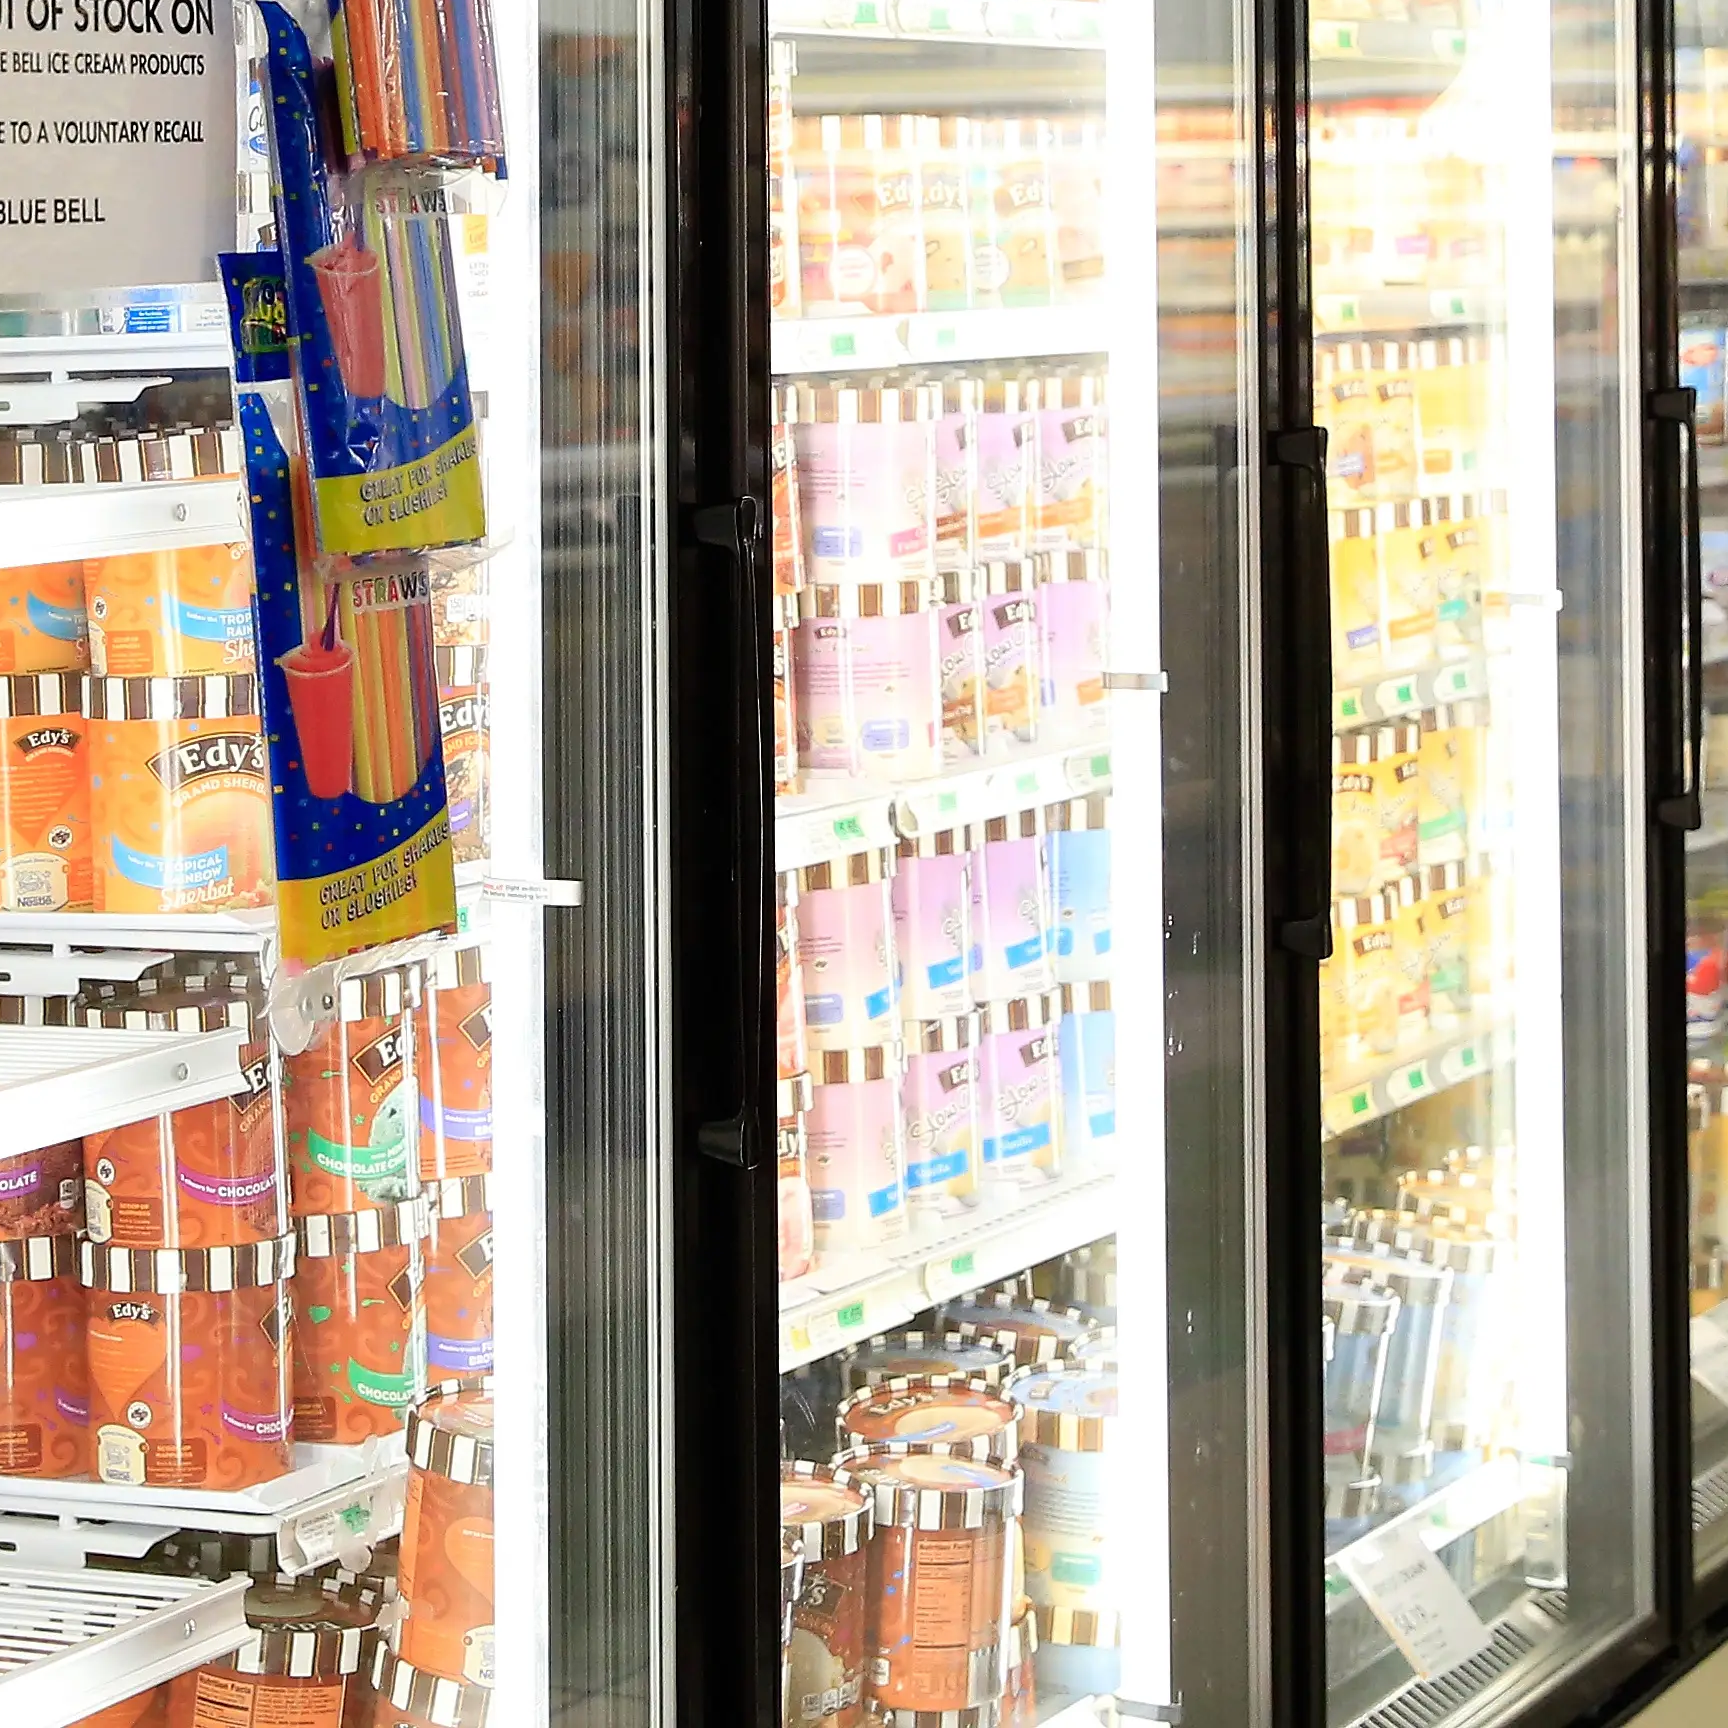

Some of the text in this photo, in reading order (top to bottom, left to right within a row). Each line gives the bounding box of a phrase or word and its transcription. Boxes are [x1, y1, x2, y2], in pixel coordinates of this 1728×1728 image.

[12, 51, 42, 73] BELL
[48, 53, 70, 74] ICE
[74, 53, 126, 75] CREAM
[130, 54, 205, 76] PRODUCTS
[10, 121, 32, 144] TO
[37, 121, 49, 143] A
[54, 120, 151, 144] VOLUNTARY
[154, 120, 204, 143] RECALL
[53, 198, 106, 224] BELL
[360, 476, 405, 503] GREAT
[407, 468, 433, 492] FOR
[352, 572, 430, 609] STRAWS
[219, 612, 253, 625] TROP
[226, 626, 253, 638] RAIN
[27, 727, 73, 748] Edy's
[179, 733, 266, 775] Edy's
[319, 822, 450, 906] GREAT FOR SHAKES
[158, 876, 235, 912] Sherbet
[321, 907, 341, 931] OR
[316, 1153, 387, 1175] CHOCOLATE
[218, 1173, 278, 1198] CHOCOLAT
[110, 1302, 154, 1322] Edy's
